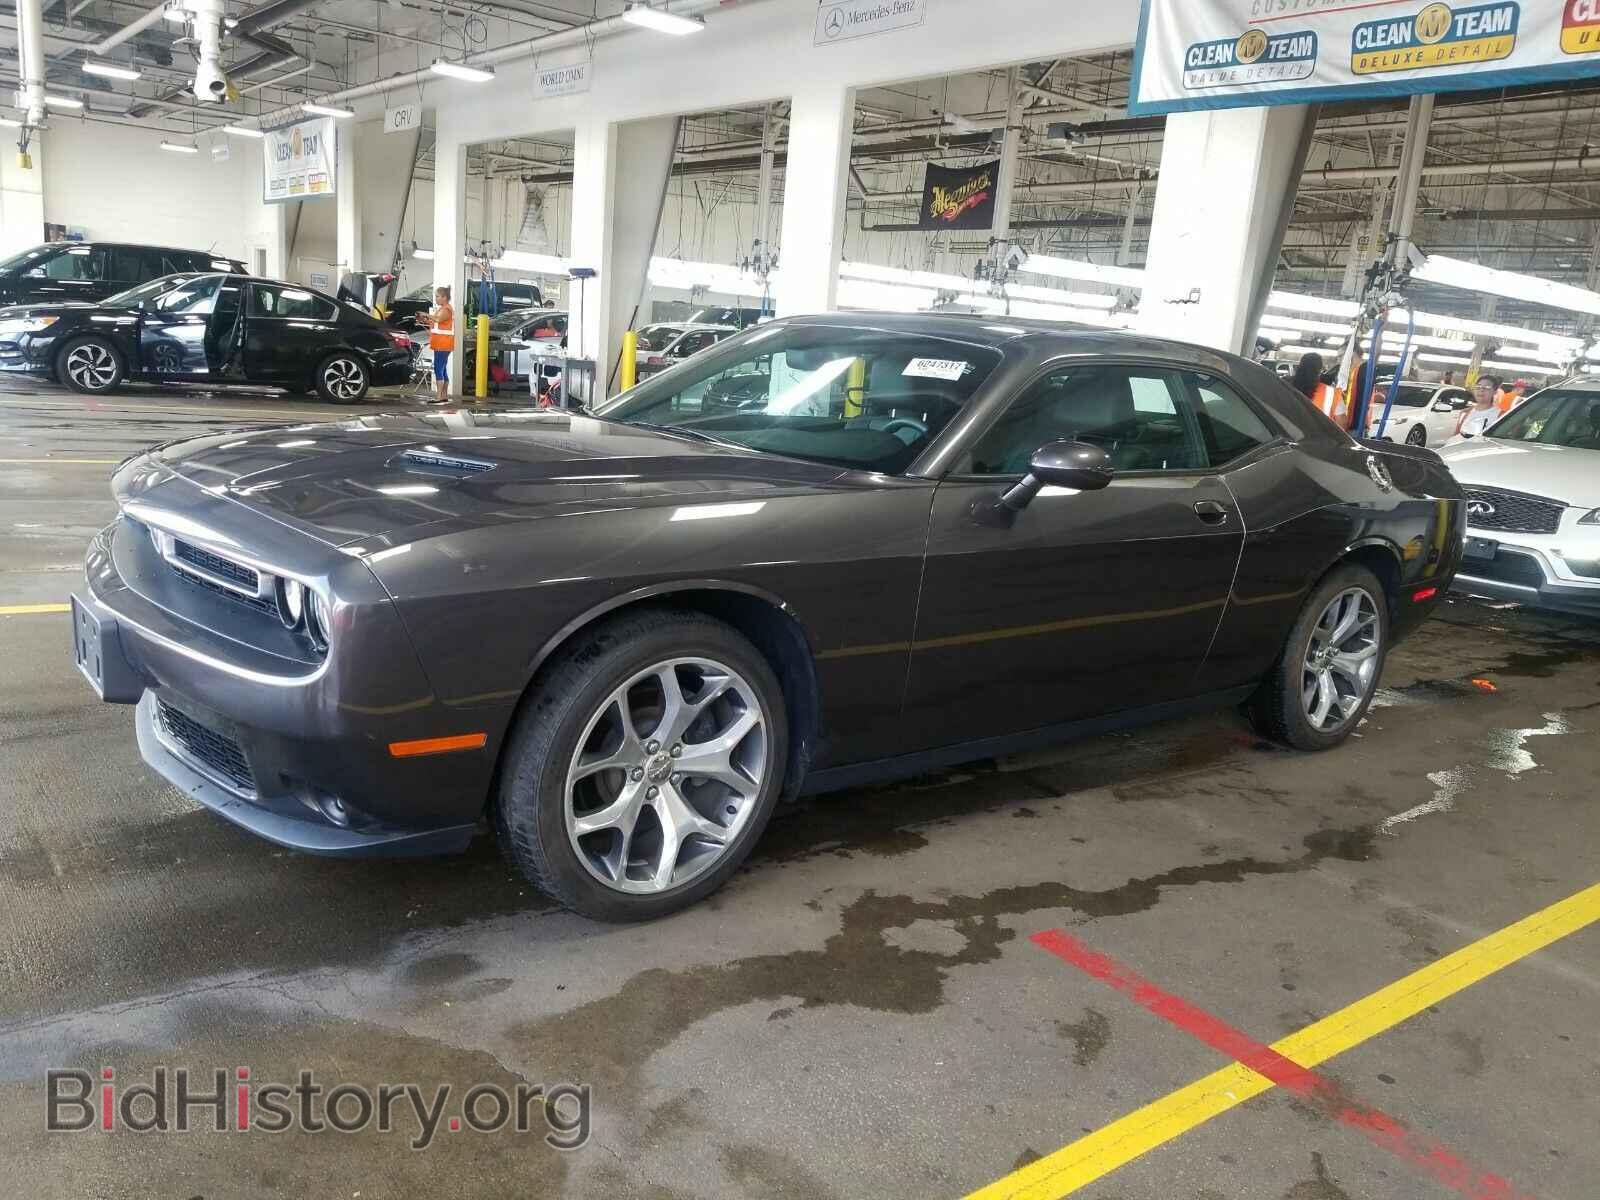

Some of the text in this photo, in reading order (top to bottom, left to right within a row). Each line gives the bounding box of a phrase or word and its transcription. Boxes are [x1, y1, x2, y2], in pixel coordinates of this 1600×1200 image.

[847, 0, 914, 25] Mercedes-Benz
[1355, 20, 1413, 50] CLEAN
[1455, 6, 1514, 37] TEAM
[1188, 43, 1235, 67] CLEAN
[1268, 35, 1313, 60] TEAM
[1360, 41, 1502, 69] DELUXE DETAIL
[1190, 63, 1307, 85] VALUE DETAIL
[394, 110, 413, 128] CRV
